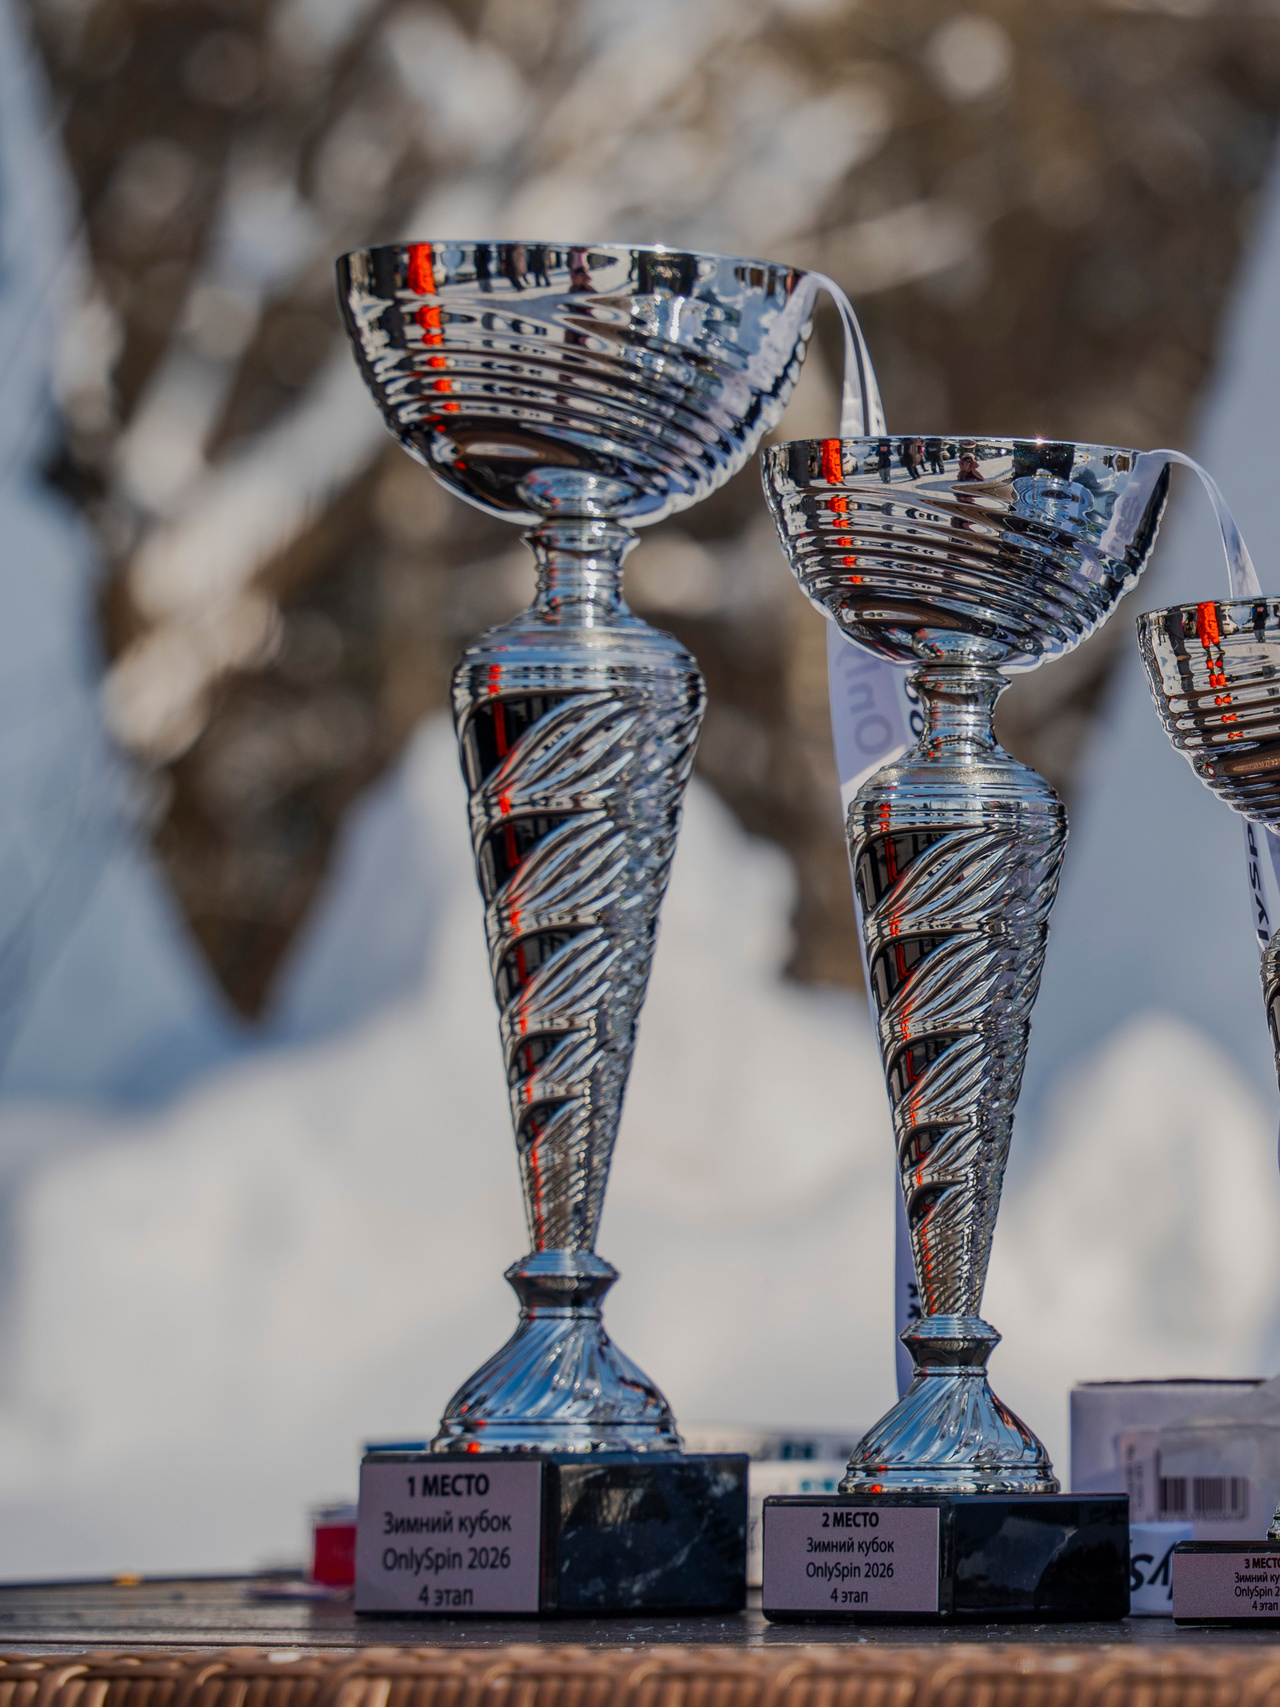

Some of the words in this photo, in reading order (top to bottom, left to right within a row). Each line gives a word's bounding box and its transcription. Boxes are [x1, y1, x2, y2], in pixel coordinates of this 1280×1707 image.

[407, 1476, 416, 1498] 1
[421, 1473, 490, 1497] МЕСТО
[383, 1510, 454, 1535] Зимний
[458, 1509, 512, 1539] кубок
[821, 1512, 830, 1528] 2
[832, 1511, 880, 1528] МЕСТО
[806, 1536, 855, 1553] Зимний
[857, 1536, 895, 1557] кубок
[382, 1546, 463, 1576] OnlySpin
[467, 1546, 511, 1570] 2026
[1244, 1558, 1251, 1570] 3
[805, 1561, 861, 1583] OnlySpin
[864, 1562, 895, 1579] 2026
[1234, 1572, 1269, 1584] Зимний
[418, 1585, 430, 1606] 4
[434, 1588, 474, 1607] этап
[830, 1587, 839, 1603] 4
[841, 1590, 869, 1604] этап
[1234, 1585, 1273, 1599] OnlySpin
[1252, 1601, 1259, 1611] 4
[1259, 1602, 1279, 1612] этап
